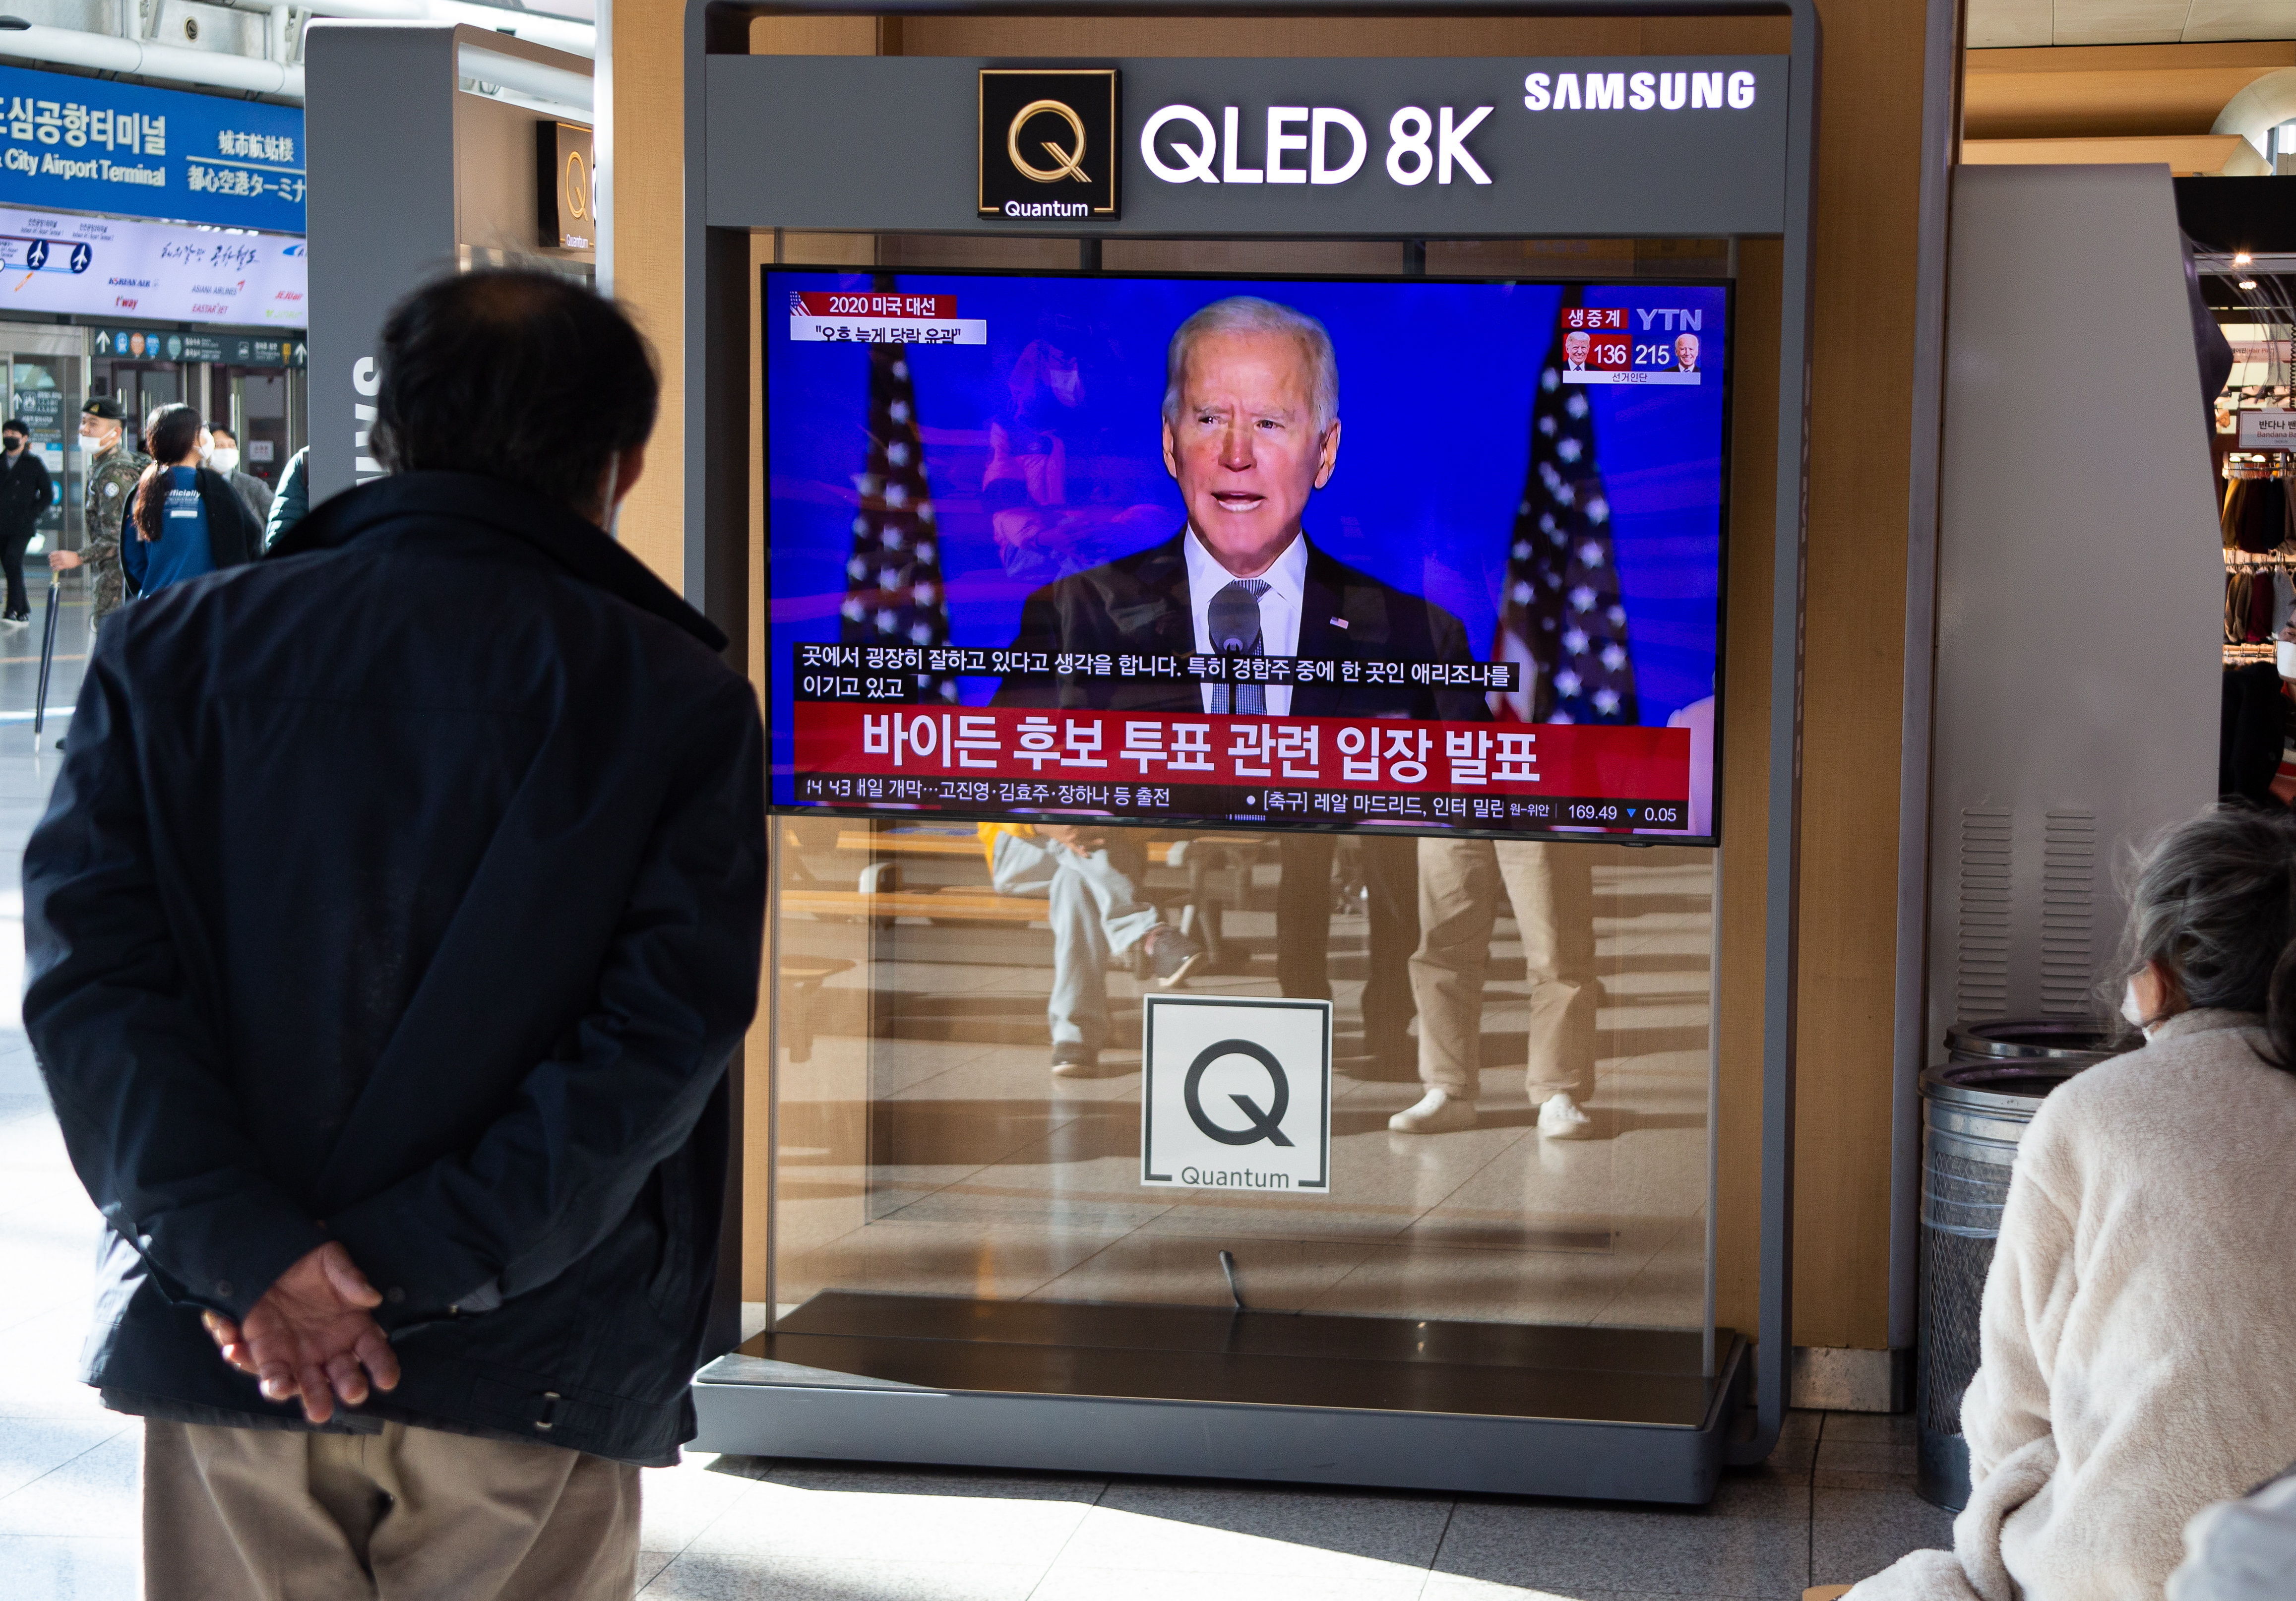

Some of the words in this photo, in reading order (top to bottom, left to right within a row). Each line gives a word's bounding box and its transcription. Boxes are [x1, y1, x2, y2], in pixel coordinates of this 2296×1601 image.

[1525, 72, 1754, 110] SAMSUNG
[218, 129, 294, 162] 城市航站楼
[1008, 100, 1092, 182] Q
[1141, 105, 1366, 184] QLED
[1386, 107, 1493, 185] 8K
[4, 148, 39, 176] City
[41, 153, 98, 180] Airport
[99, 159, 166, 186] Terminal
[566, 151, 589, 221] Q
[1005, 201, 1088, 216] Quantum
[566, 234, 589, 248] Quantum
[830, 297, 868, 313] 2020
[872, 298, 902, 315] 미국
[907, 298, 934, 315] 대선
[1569, 309, 1619, 327] 생중계
[1637, 309, 1701, 330] YTN
[1595, 345, 1626, 364] 136
[1635, 345, 1669, 364] 215
[1612, 373, 1648, 383] 선거인단
[2259, 420, 2285, 430] 반다나
[803, 646, 859, 667] 곳에서
[866, 648, 922, 669] 굉장히
[929, 650, 986, 671] 잘하고
[992, 652, 1049, 672] 있다고
[1055, 653, 1112, 675] 생각을
[1119, 655, 1180, 677] 합니다.
[1187, 657, 1225, 678] 특히
[1233, 659, 1290, 680] 경합주
[1296, 661, 1334, 681] 중에
[1342, 661, 1361, 681] 한
[1366, 663, 1404, 683] 곳인
[1412, 663, 1510, 686] 애리조나를
[804, 676, 860, 696] 이기고
[867, 678, 904, 698] 있고
[864, 713, 1001, 768] 바이든
[1014, 717, 1107, 770] 후보
[1120, 721, 1214, 773] 투표
[1228, 724, 1319, 778] 관련
[1337, 727, 1432, 783] 입장
[1446, 731, 1540, 784] 발표
[1114, 787, 1131, 805] 등
[1136, 787, 1169, 806] 출전
[1264, 791, 1307, 811] [축구]
[1315, 794, 1348, 812] 레알
[1354, 795, 1426, 816] 마드리드,
[1433, 798, 1466, 816] 인터
[1510, 803, 1549, 816] 원-위안
[1569, 805, 1617, 819] 169.49
[1645, 807, 1676, 821] 0.05
[1184, 1039, 1295, 1147] Q
[1181, 1166, 1289, 1188] Quantum
